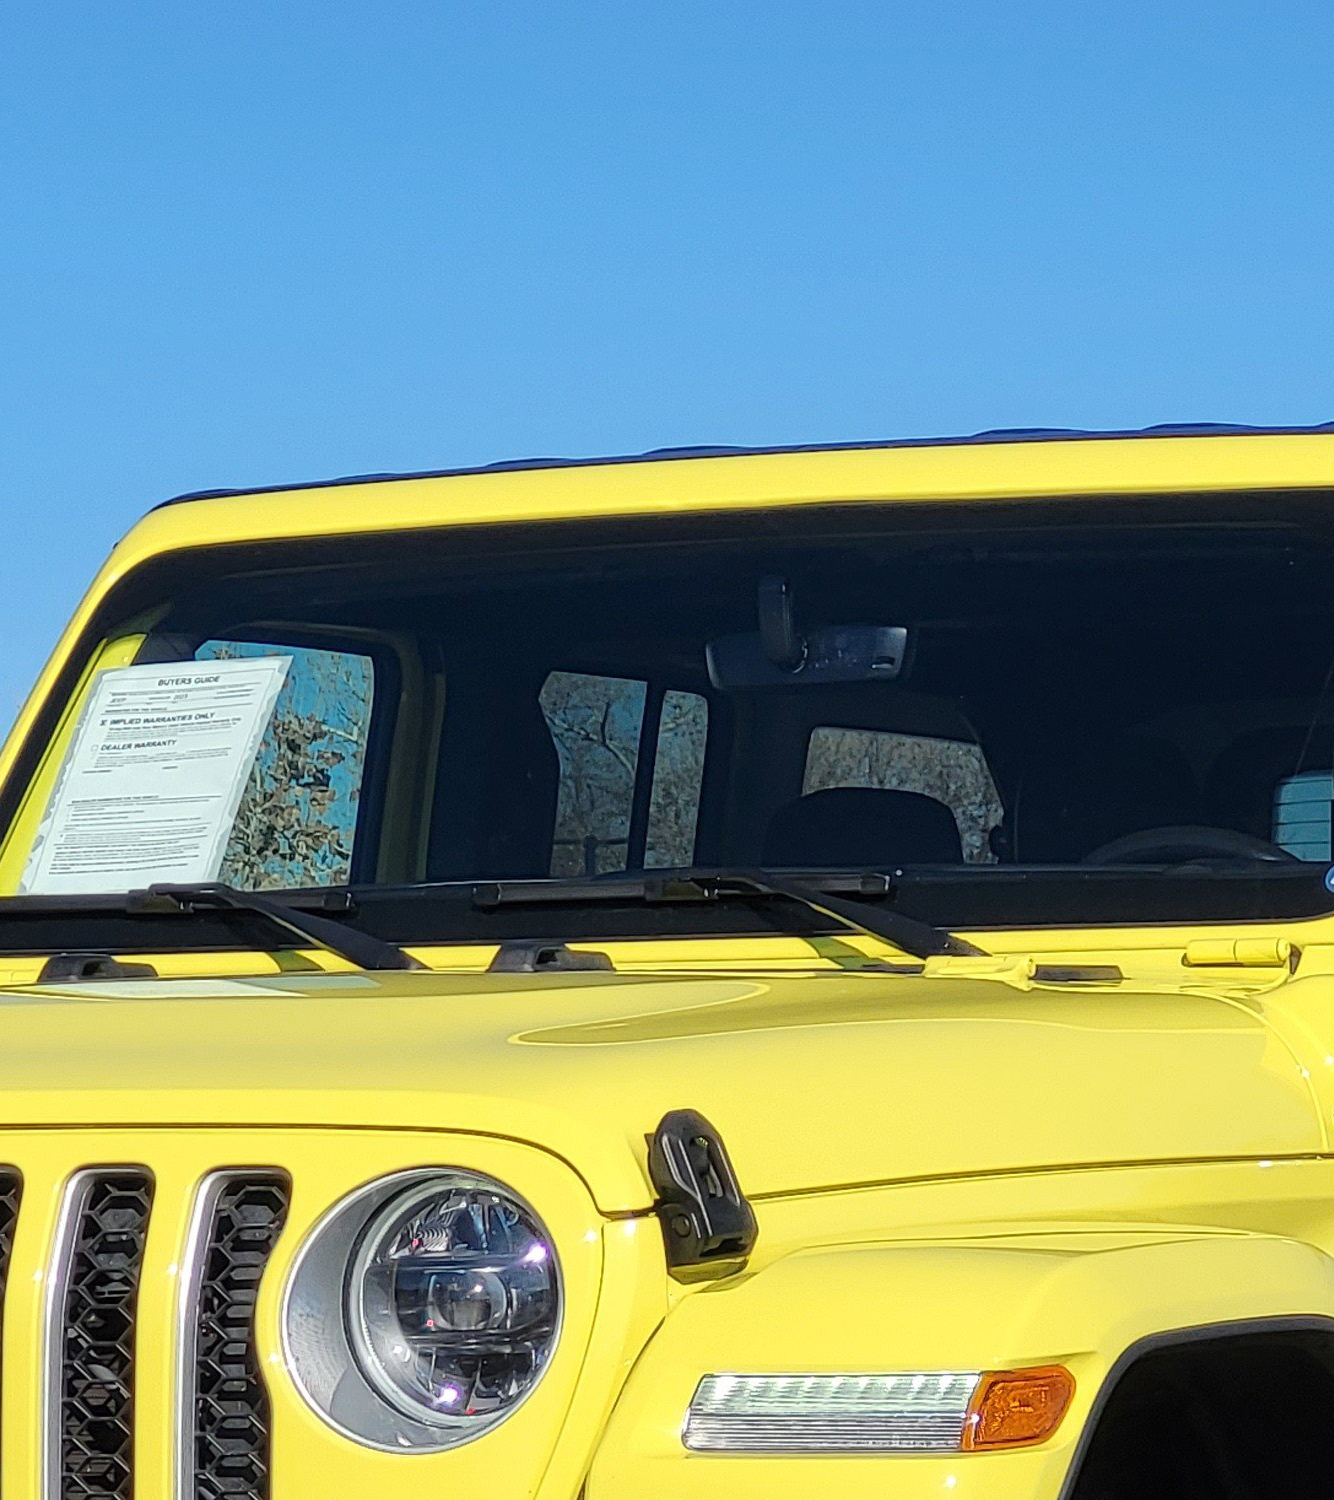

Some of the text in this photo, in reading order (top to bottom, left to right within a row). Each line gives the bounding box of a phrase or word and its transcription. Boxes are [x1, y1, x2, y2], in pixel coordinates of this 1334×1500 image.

[157, 675, 221, 687] BUYERS GUIDE
[109, 717, 142, 726] IMPLIED
[143, 713, 193, 724] WARRANTIES
[194, 711, 216, 720] ONLY
[100, 740, 178, 751] DEALER WARRANTY
